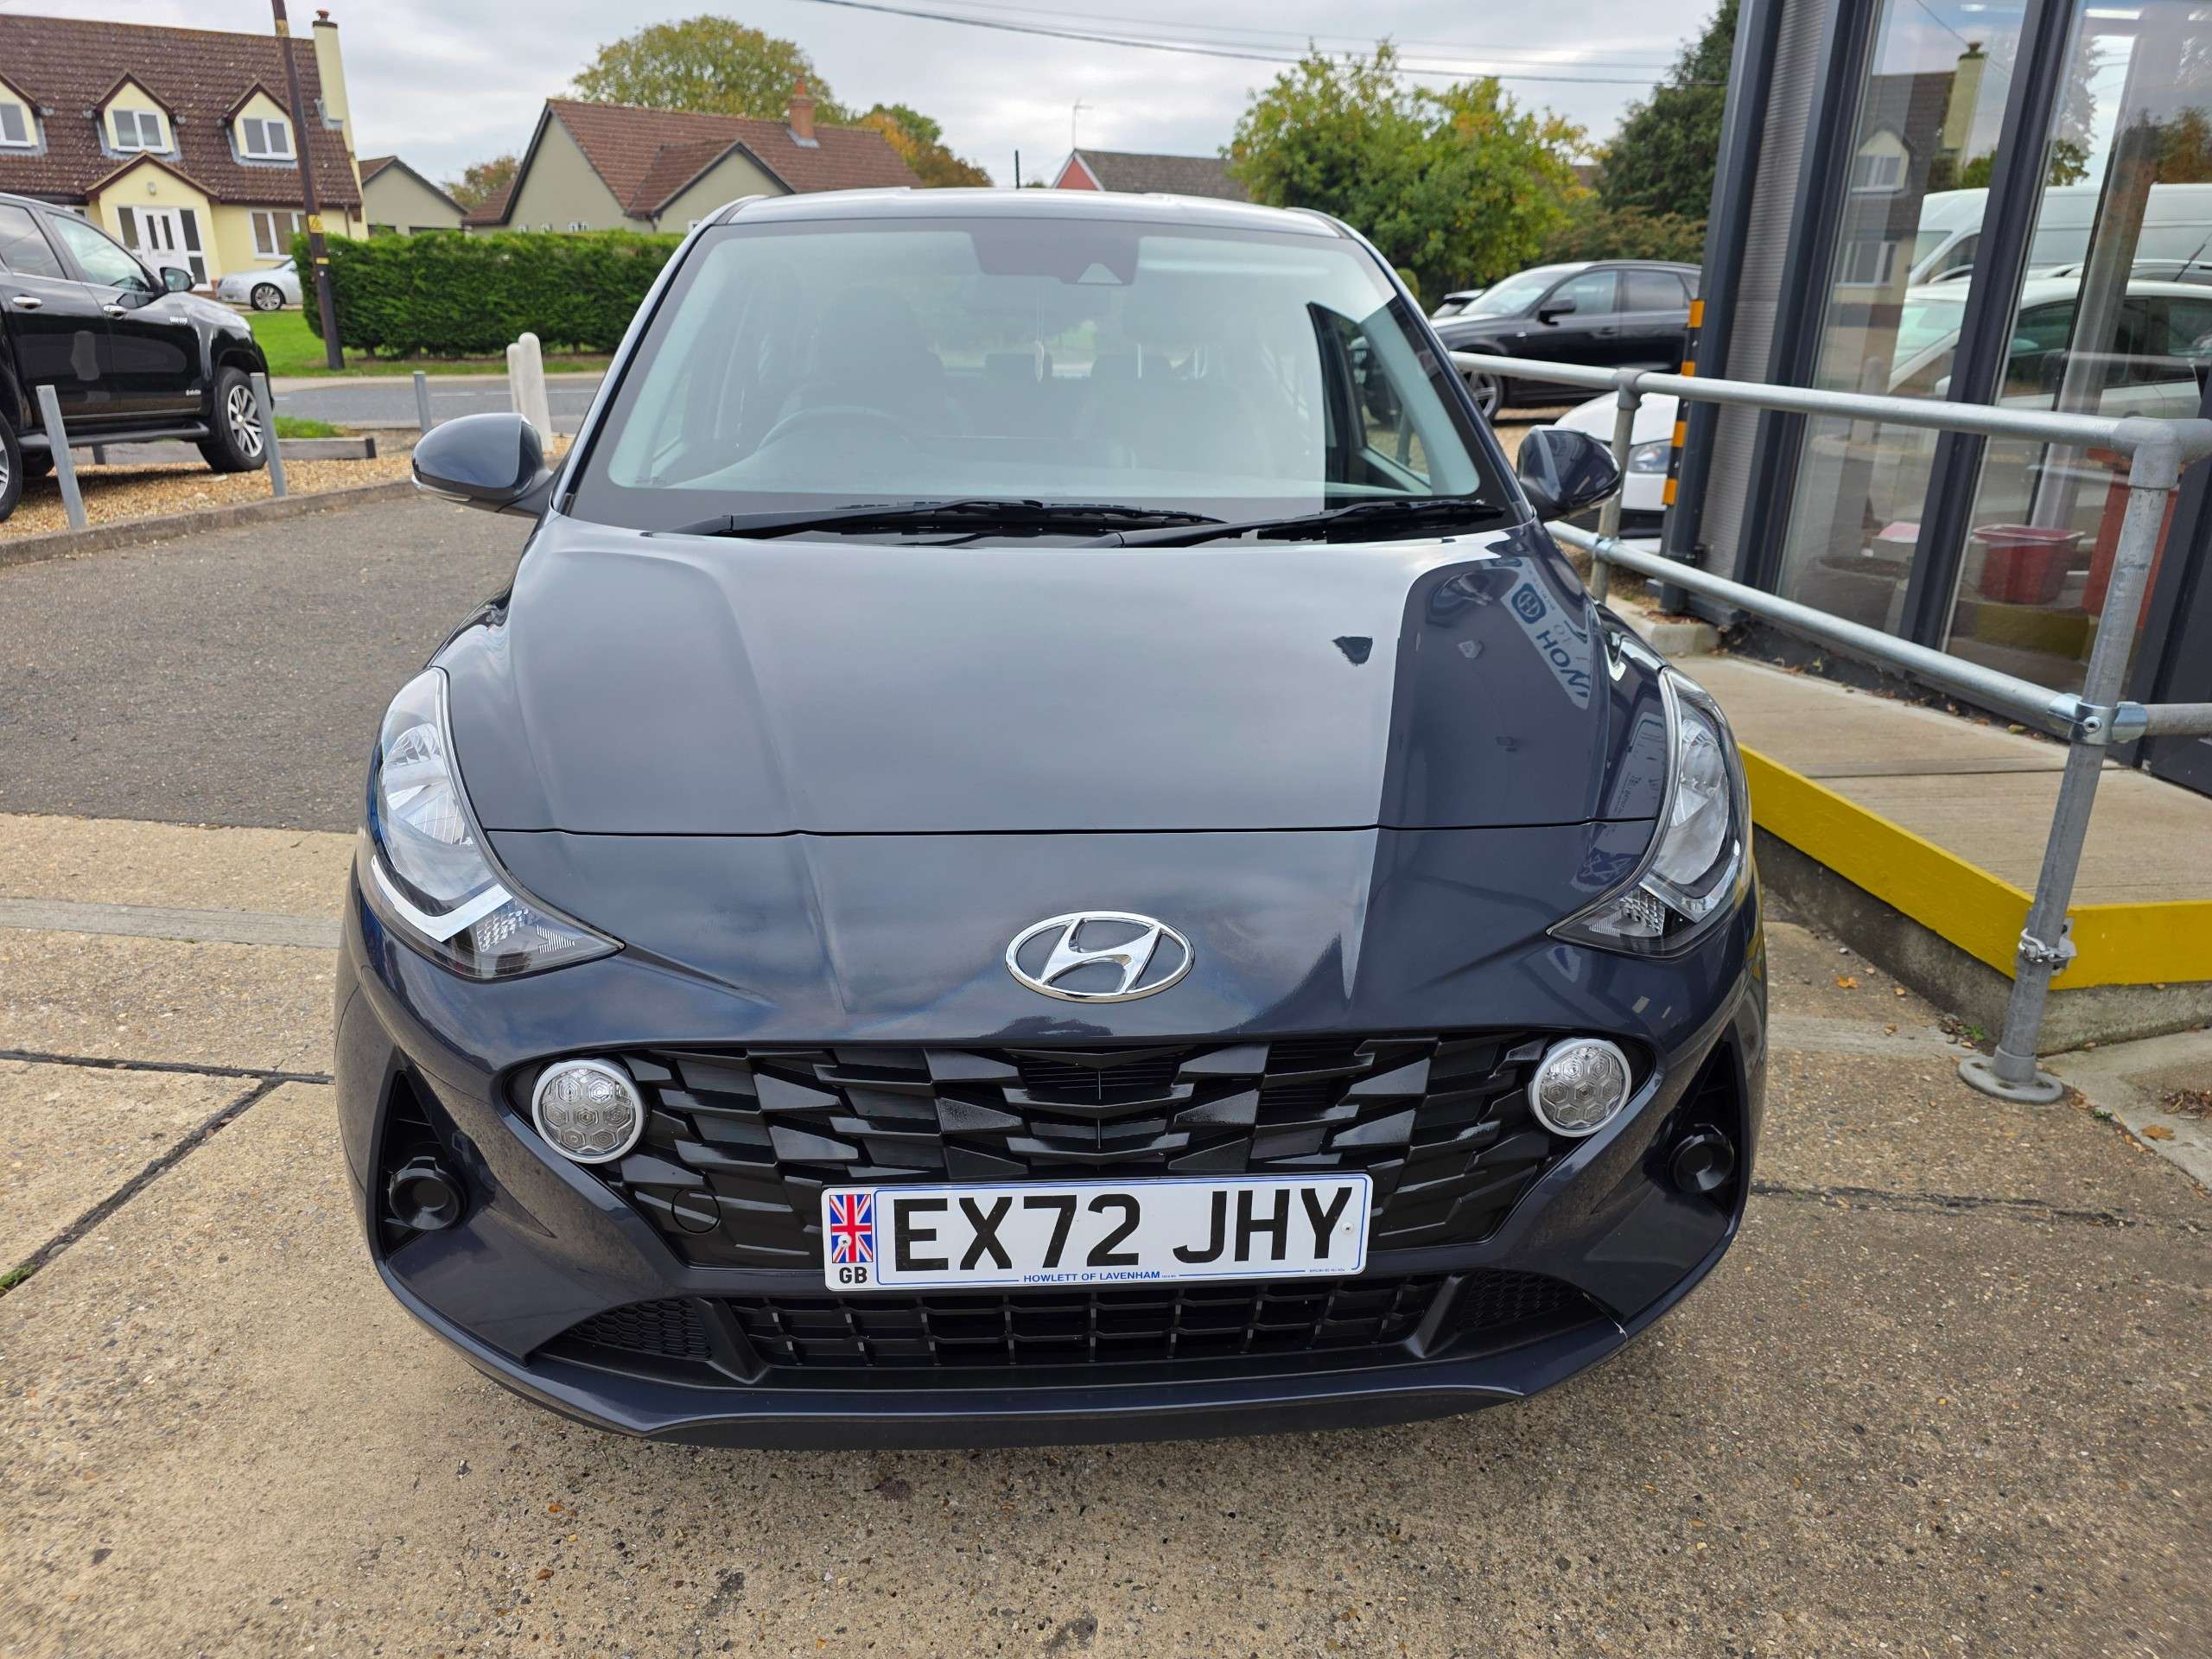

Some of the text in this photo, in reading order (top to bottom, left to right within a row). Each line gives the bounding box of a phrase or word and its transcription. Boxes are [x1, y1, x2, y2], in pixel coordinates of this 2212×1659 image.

[893, 1186, 1353, 1272] EX72 JHY
[839, 1266, 868, 1284] GB
[1023, 1274, 1078, 1282] HOWLETT
[1081, 1273, 1097, 1281] OF
[1099, 1271, 1160, 1281] LAVENHAM
